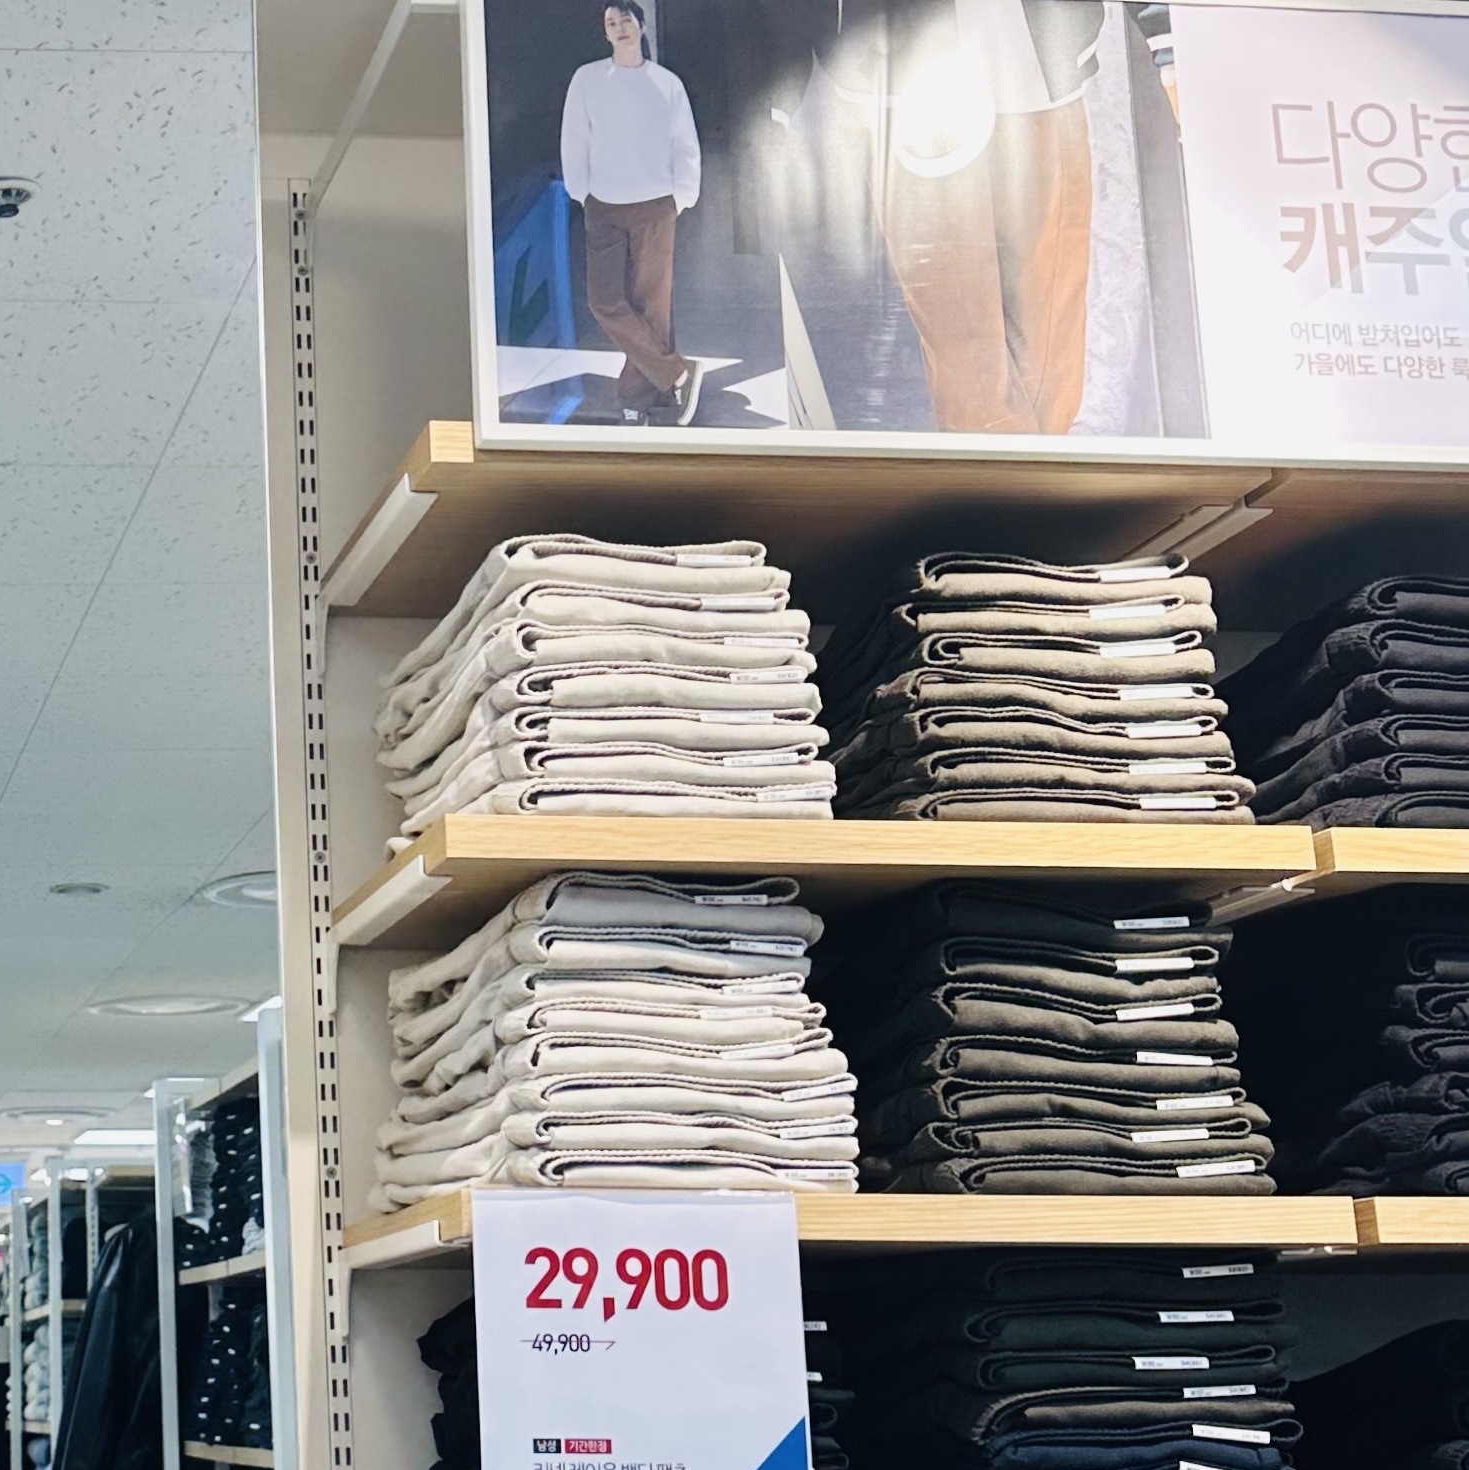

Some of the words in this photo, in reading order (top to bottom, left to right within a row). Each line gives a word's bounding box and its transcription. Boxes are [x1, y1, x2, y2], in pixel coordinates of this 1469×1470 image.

[1290, 321, 1353, 347] 어디에
[1358, 323, 1464, 349] 받쳐입어도
[1293, 352, 1378, 378] 가을에도
[1383, 354, 1446, 380] 다양한
[524, 1246, 729, 1323] 29,900
[532, 1333, 591, 1355] 49,900
[536, 1439, 557, 1453] 남성
[568, 1440, 608, 1453] 기간한정
